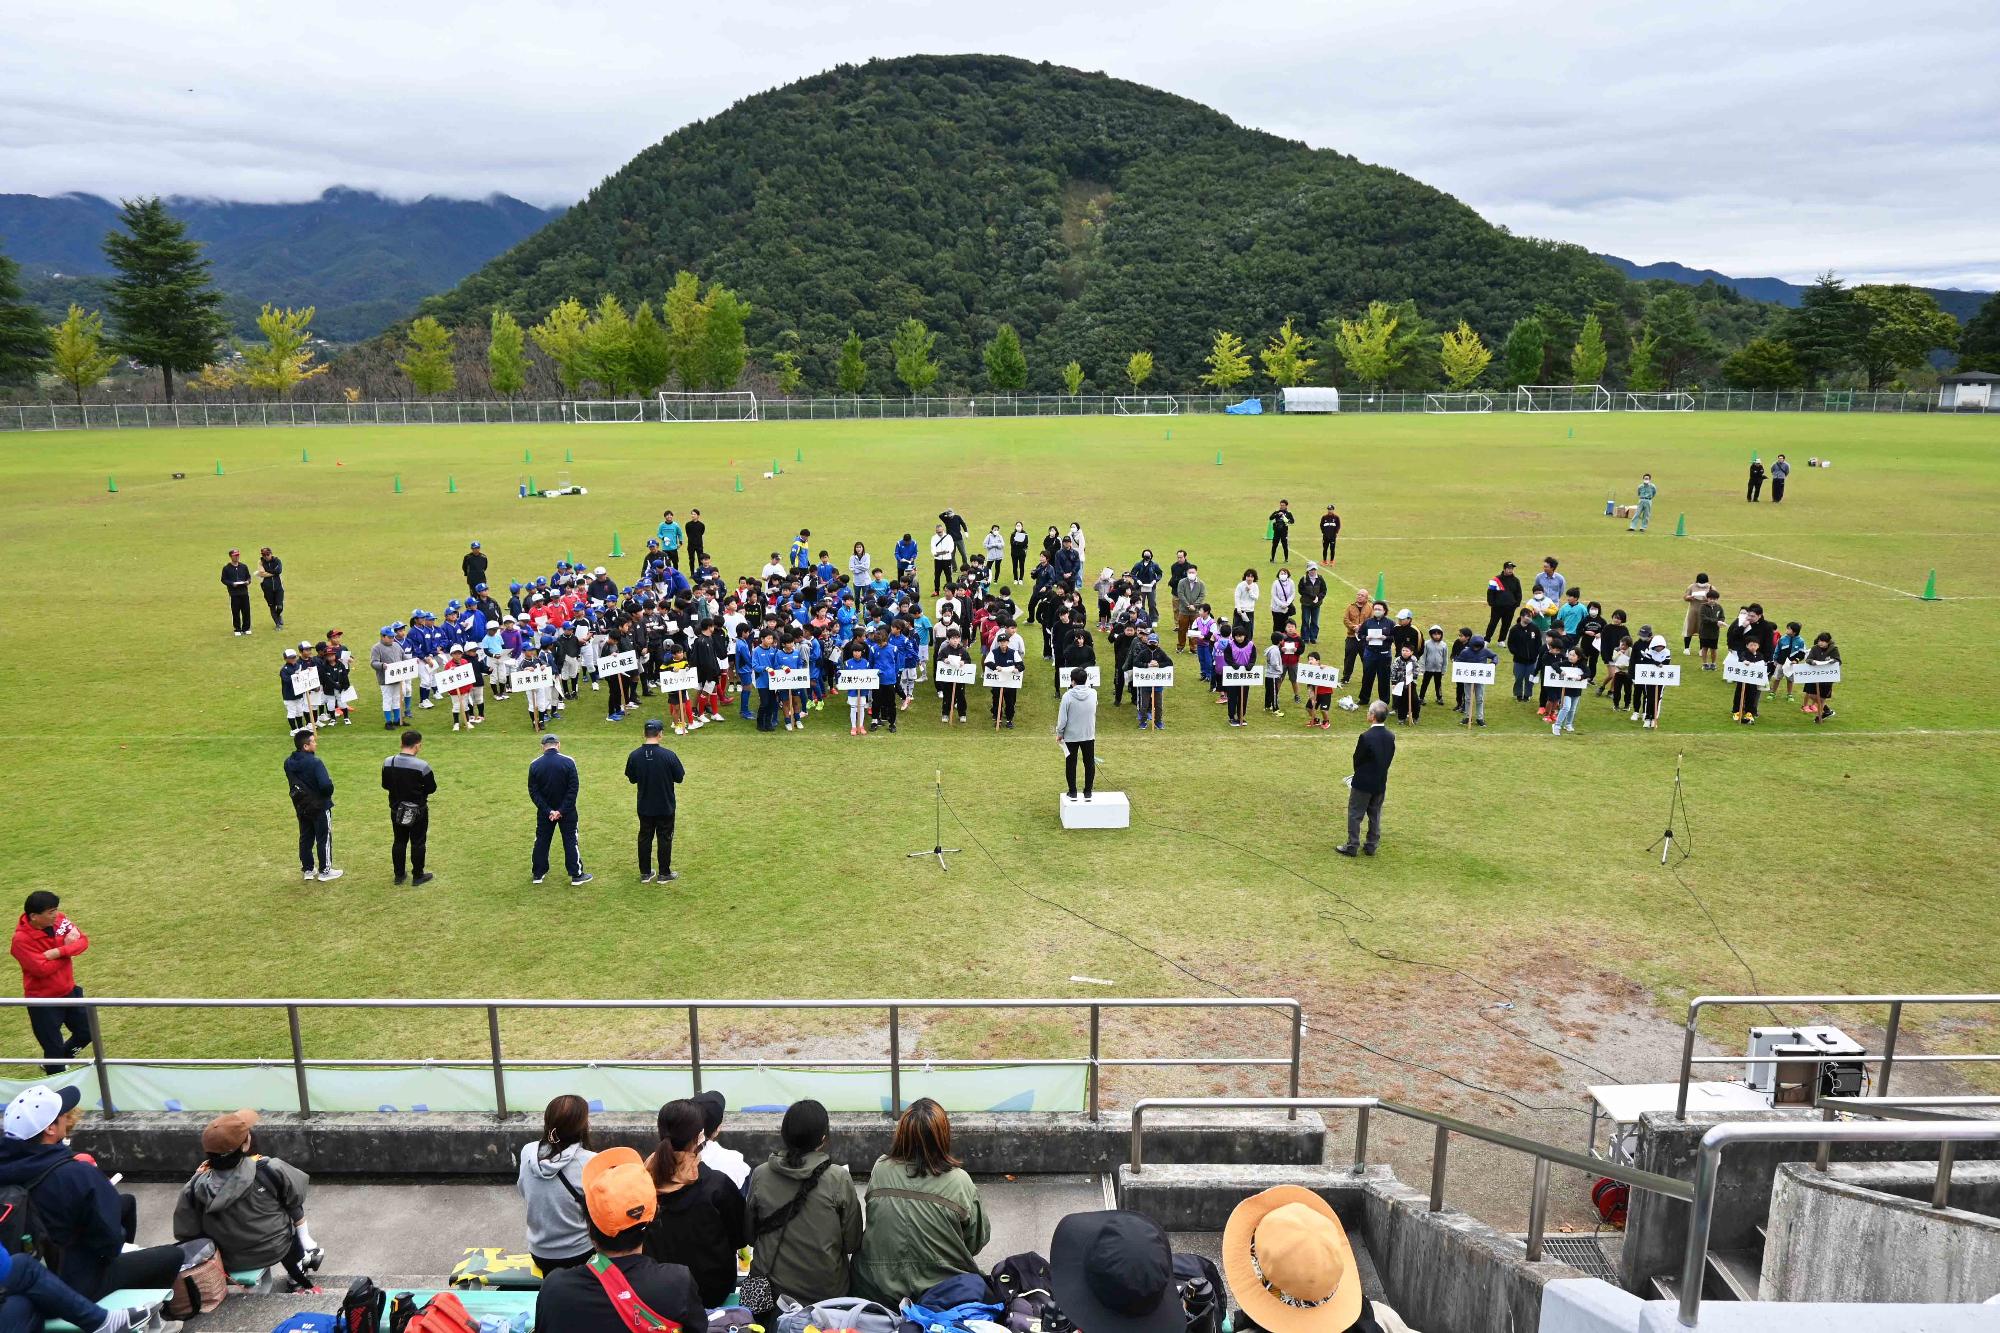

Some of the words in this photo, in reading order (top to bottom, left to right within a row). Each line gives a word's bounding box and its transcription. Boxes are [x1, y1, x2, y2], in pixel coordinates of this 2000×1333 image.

[602, 660, 618, 671] JFC
[517, 674, 548, 685] 双葉野球
[1640, 670, 1674, 679] 双葉柔道
[840, 676, 877, 684] 双葉サッカー
